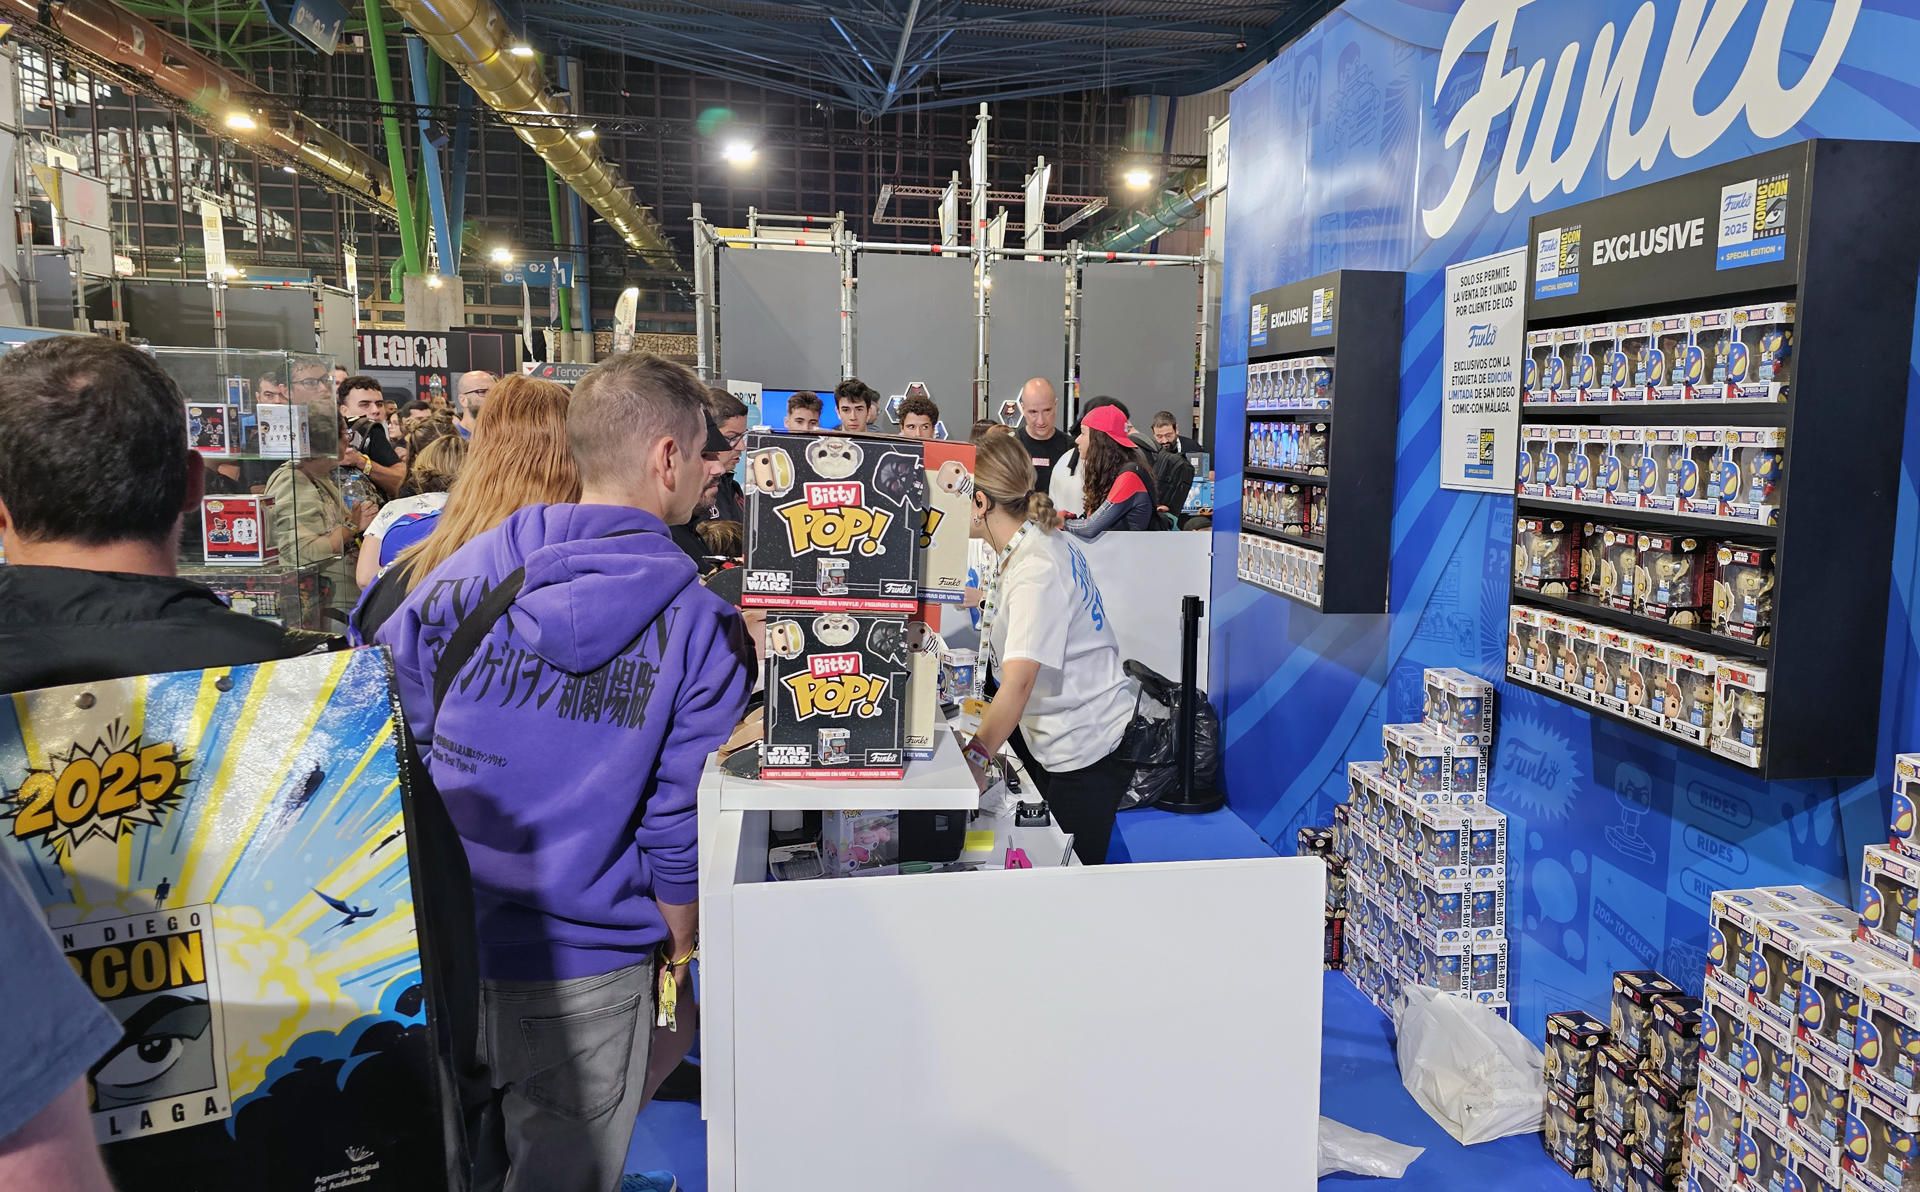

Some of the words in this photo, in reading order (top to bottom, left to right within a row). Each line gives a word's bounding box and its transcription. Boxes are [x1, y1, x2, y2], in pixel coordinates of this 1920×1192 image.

[1423, 0, 1862, 239] Funko
[1724, 192, 1752, 212] Funko
[1755, 185, 1768, 231] COMIC
[1768, 178, 1788, 199] CON
[1724, 222, 1748, 236] 2025
[1540, 238, 1558, 254] Funko
[1560, 234, 1568, 269] COMIC
[1568, 230, 1582, 244] CON
[1592, 217, 1705, 266] EXCLUSIVE
[1726, 250, 1750, 260] SPECIAL
[1750, 245, 1776, 256] EDITION
[539, 264, 546, 273] 2
[558, 268, 566, 284] 1
[1460, 275, 1474, 288] SOLO
[1476, 272, 1483, 284] SE
[1484, 266, 1510, 282] PERMITE
[1540, 262, 1556, 272] 2025
[1454, 292, 1460, 302] LA
[1462, 288, 1479, 301] VENTA
[1480, 286, 1488, 298] DE
[1494, 280, 1518, 296] UNIDAD
[1271, 306, 1309, 328] EXCLUSIVE
[1456, 304, 1468, 317] POR
[1468, 300, 1492, 314] CLIENTE
[1492, 298, 1500, 310] DE
[1502, 296, 1514, 308] LOS
[1468, 323, 1496, 348] Funko
[363, 335, 448, 368] LEGION
[1454, 358, 1488, 372] EXCLUSIVOS
[1488, 358, 1502, 369] CON
[1502, 356, 1511, 368] LA
[1452, 374, 1478, 386] ETIQUETA
[1478, 373, 1487, 384] DE
[1488, 368, 1512, 384] EDICIÓN
[1448, 388, 1474, 400] LIMITADA
[1474, 388, 1482, 399] DE
[1483, 388, 1495, 398] SAN
[1496, 386, 1516, 398] DIEGO
[1452, 402, 1484, 414] COMIC-CON
[1484, 400, 1512, 414] MÁLAGA.
[811, 485, 858, 507] Bitty
[780, 501, 889, 556] POP!
[747, 580, 790, 592] WARS
[752, 572, 787, 582] STAR
[884, 582, 913, 594] Funko
[939, 577, 961, 588] Funko
[918, 592, 938, 600] GURAS
[814, 656, 856, 676] Bitty
[786, 672, 884, 719] POP!
[1484, 686, 1492, 734] SPIDER-BOY
[770, 747, 809, 756] STAR
[906, 736, 928, 745] Funko
[767, 755, 810, 765] WARS
[870, 752, 896, 763] Funko
[1503, 737, 1560, 791] Funko
[1478, 746, 1487, 794] SPIDER-BOY
[14, 741, 178, 841] 2025
[1700, 787, 1738, 818] RIDES
[1460, 818, 1470, 866] SPIDER-BOY
[1497, 818, 1506, 866] SPIDER-BOY
[1697, 833, 1734, 863] RIDES
[1694, 877, 1718, 896] RID
[1463, 882, 1472, 929] SPIDER-BOY
[1496, 880, 1504, 926] SPIDER-BOY
[104, 912, 200, 942] DIEGO
[1595, 903, 1614, 925] 200+
[1614, 920, 1624, 936] TO
[1625, 931, 1658, 964] COLLECT
[90, 932, 205, 999] CON
[1462, 944, 1470, 992] SPIDER-BOY
[109, 1096, 218, 1136] LAGA
[314, 1170, 350, 1184] Agencia
[351, 1161, 380, 1174] Digital
